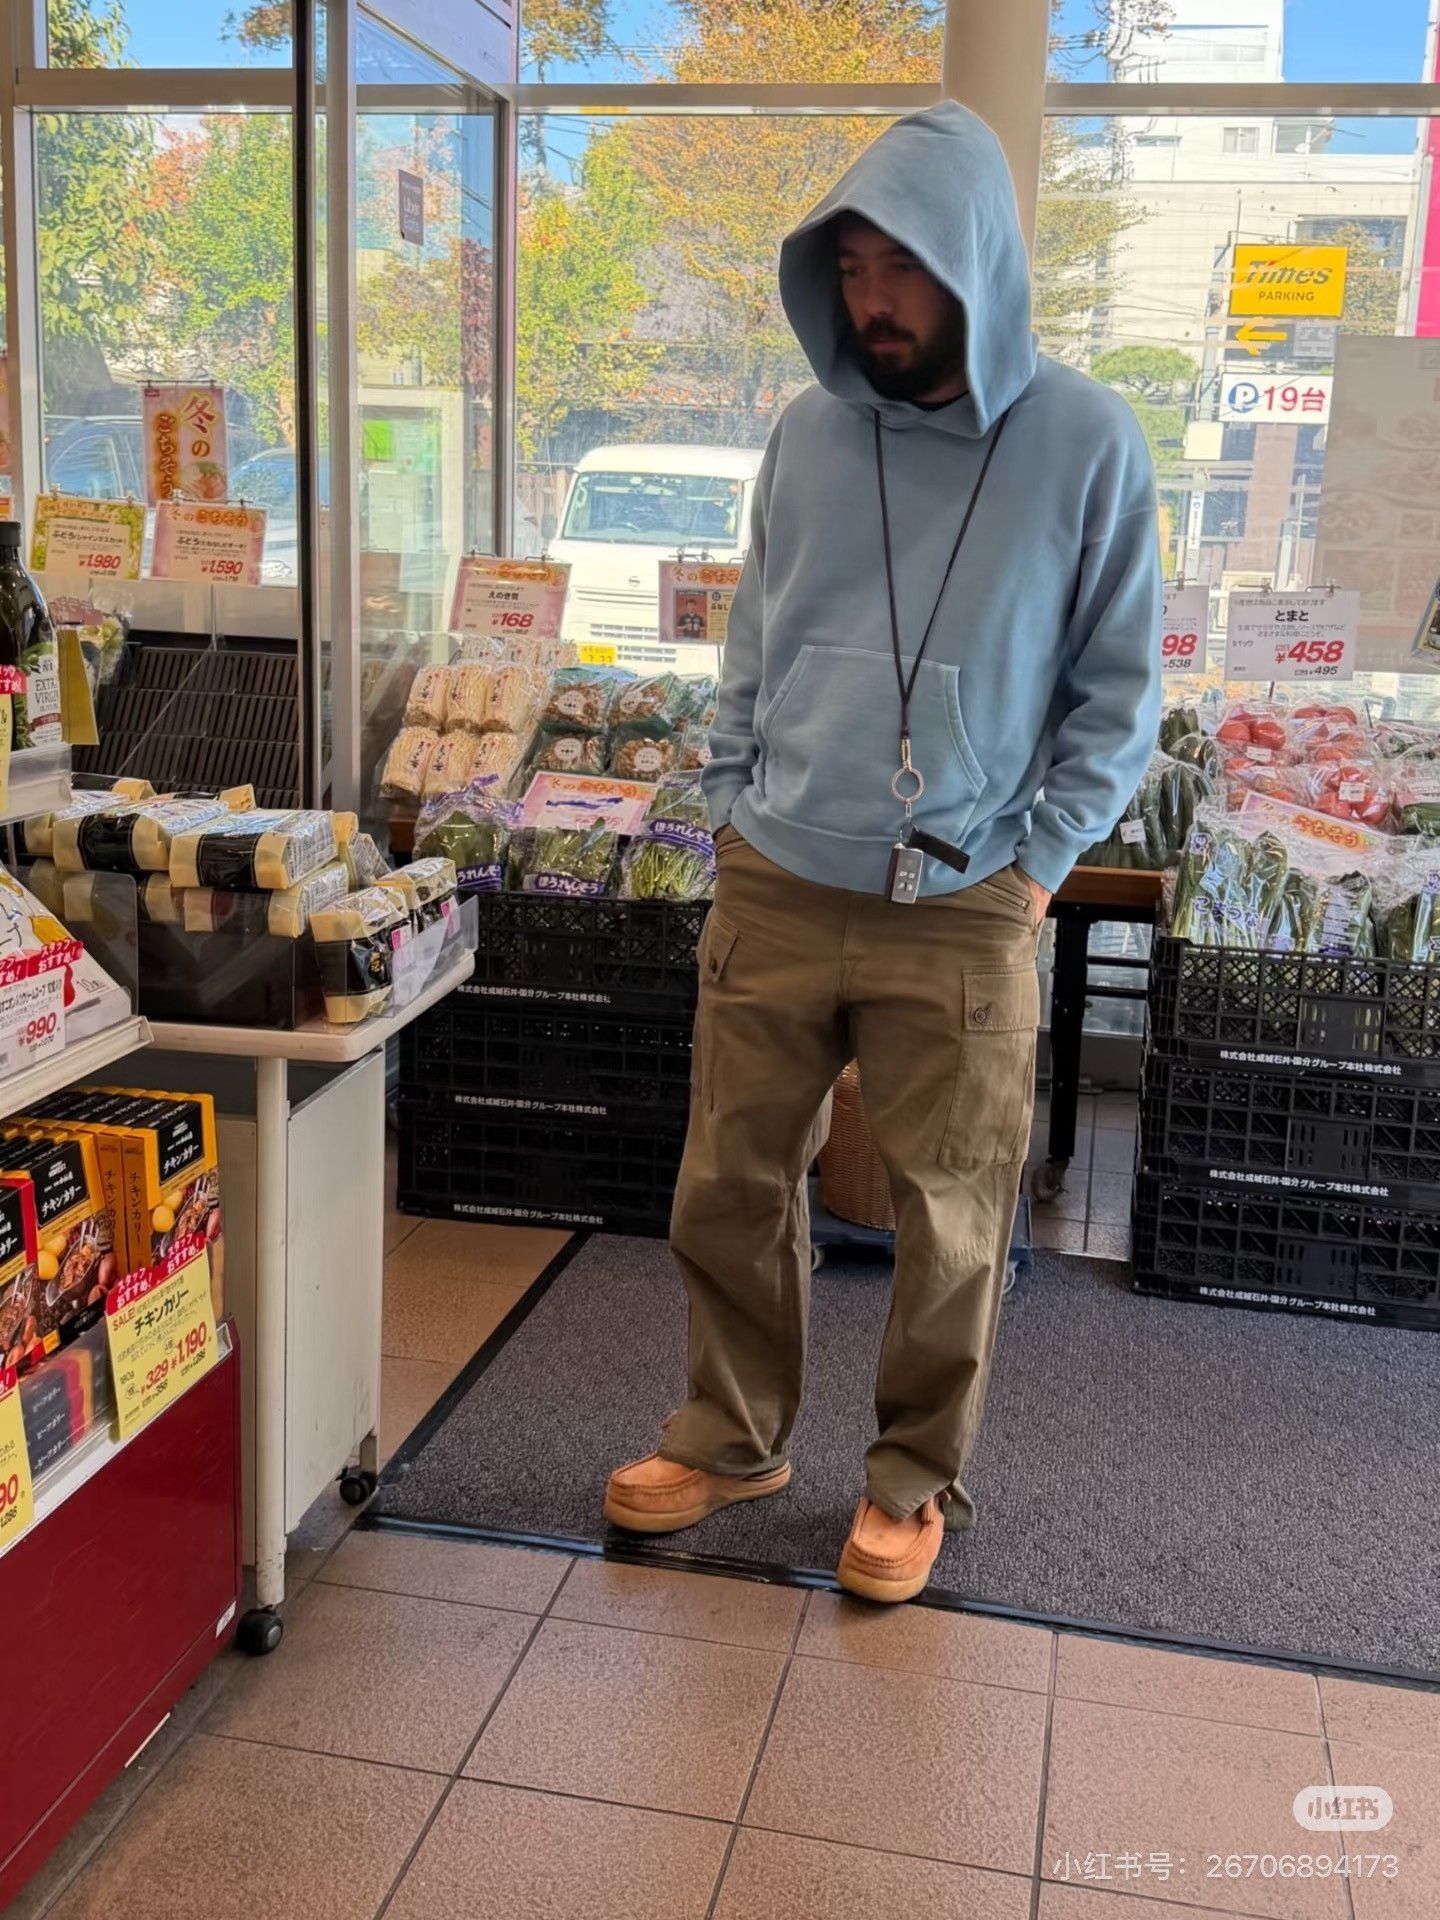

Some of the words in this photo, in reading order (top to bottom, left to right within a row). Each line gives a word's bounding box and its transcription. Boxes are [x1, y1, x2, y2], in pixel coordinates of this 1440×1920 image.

[1244, 260, 1333, 285] Times
[1258, 290, 1315, 302] PARKING
[1263, 386, 1326, 412] 19台
[185, 396, 215, 458] 冬の
[1275, 610, 1309, 622] とまと
[655, 821, 714, 845] ほうれんそう
[1194, 897, 1258, 928] こまつな
[163, 1144, 199, 1175] チキンカリー
[41, 1185, 82, 1218] チキンカリー
[129, 1171, 142, 1244] チキンカリー
[134, 1289, 189, 1336] チキンカリー
